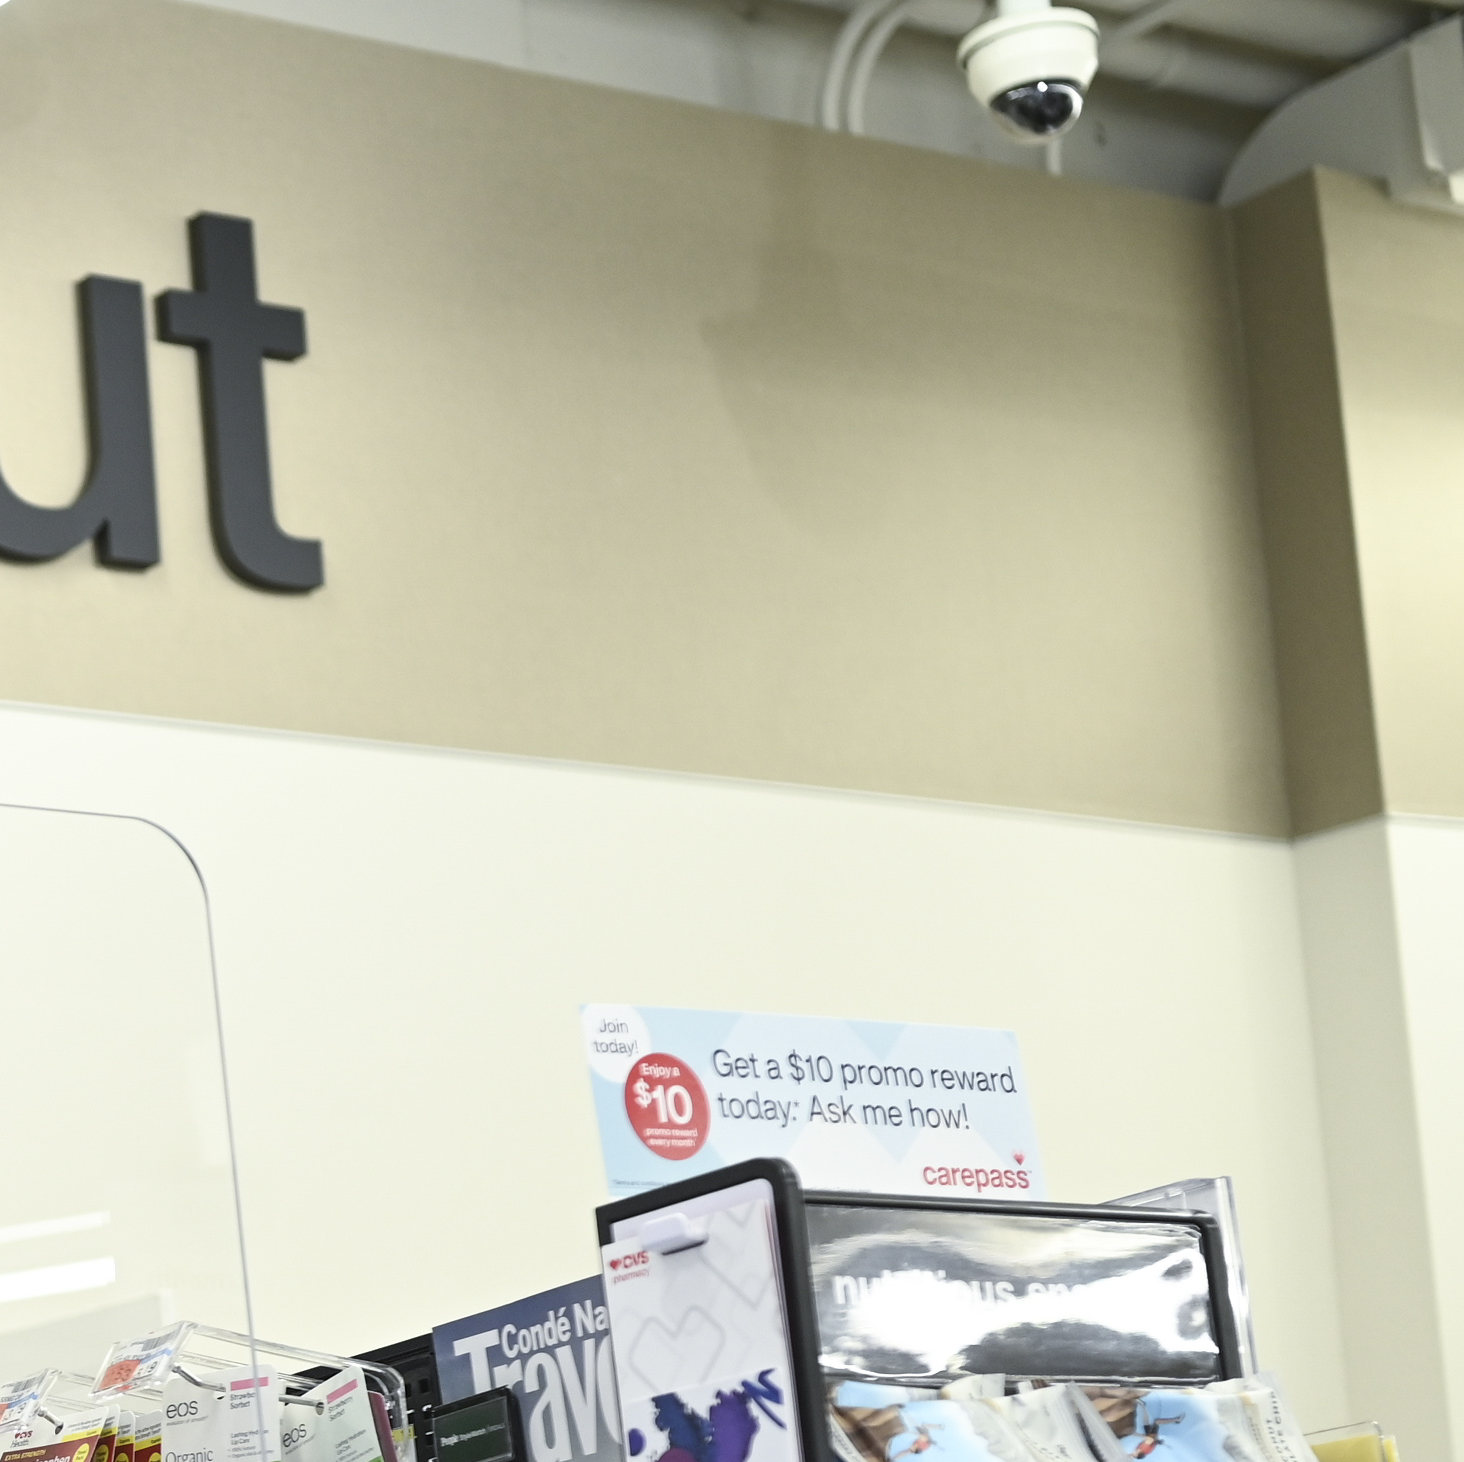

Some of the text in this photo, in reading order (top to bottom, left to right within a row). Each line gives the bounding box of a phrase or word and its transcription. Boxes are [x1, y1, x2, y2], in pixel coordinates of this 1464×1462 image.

[599, 1019, 629, 1033] Join
[593, 1039, 638, 1057] today!
[639, 1062, 672, 1078] Enjoy
[712, 1049, 1017, 1094] Get a $10 promo reward
[633, 1077, 693, 1125] $10
[809, 1095, 971, 1130] Ask me how!
[922, 1164, 1031, 1192] carepass
[622, 1252, 650, 1270] CVS
[612, 1266, 650, 1286] pharmacy
[501, 1299, 610, 1358] Condé Na
[166, 1400, 198, 1419] eos
[230, 1400, 251, 1410] Sorbet
[283, 1424, 307, 1448] eos
[4, 1449, 46, 1461] EXTRA STRENGTH
